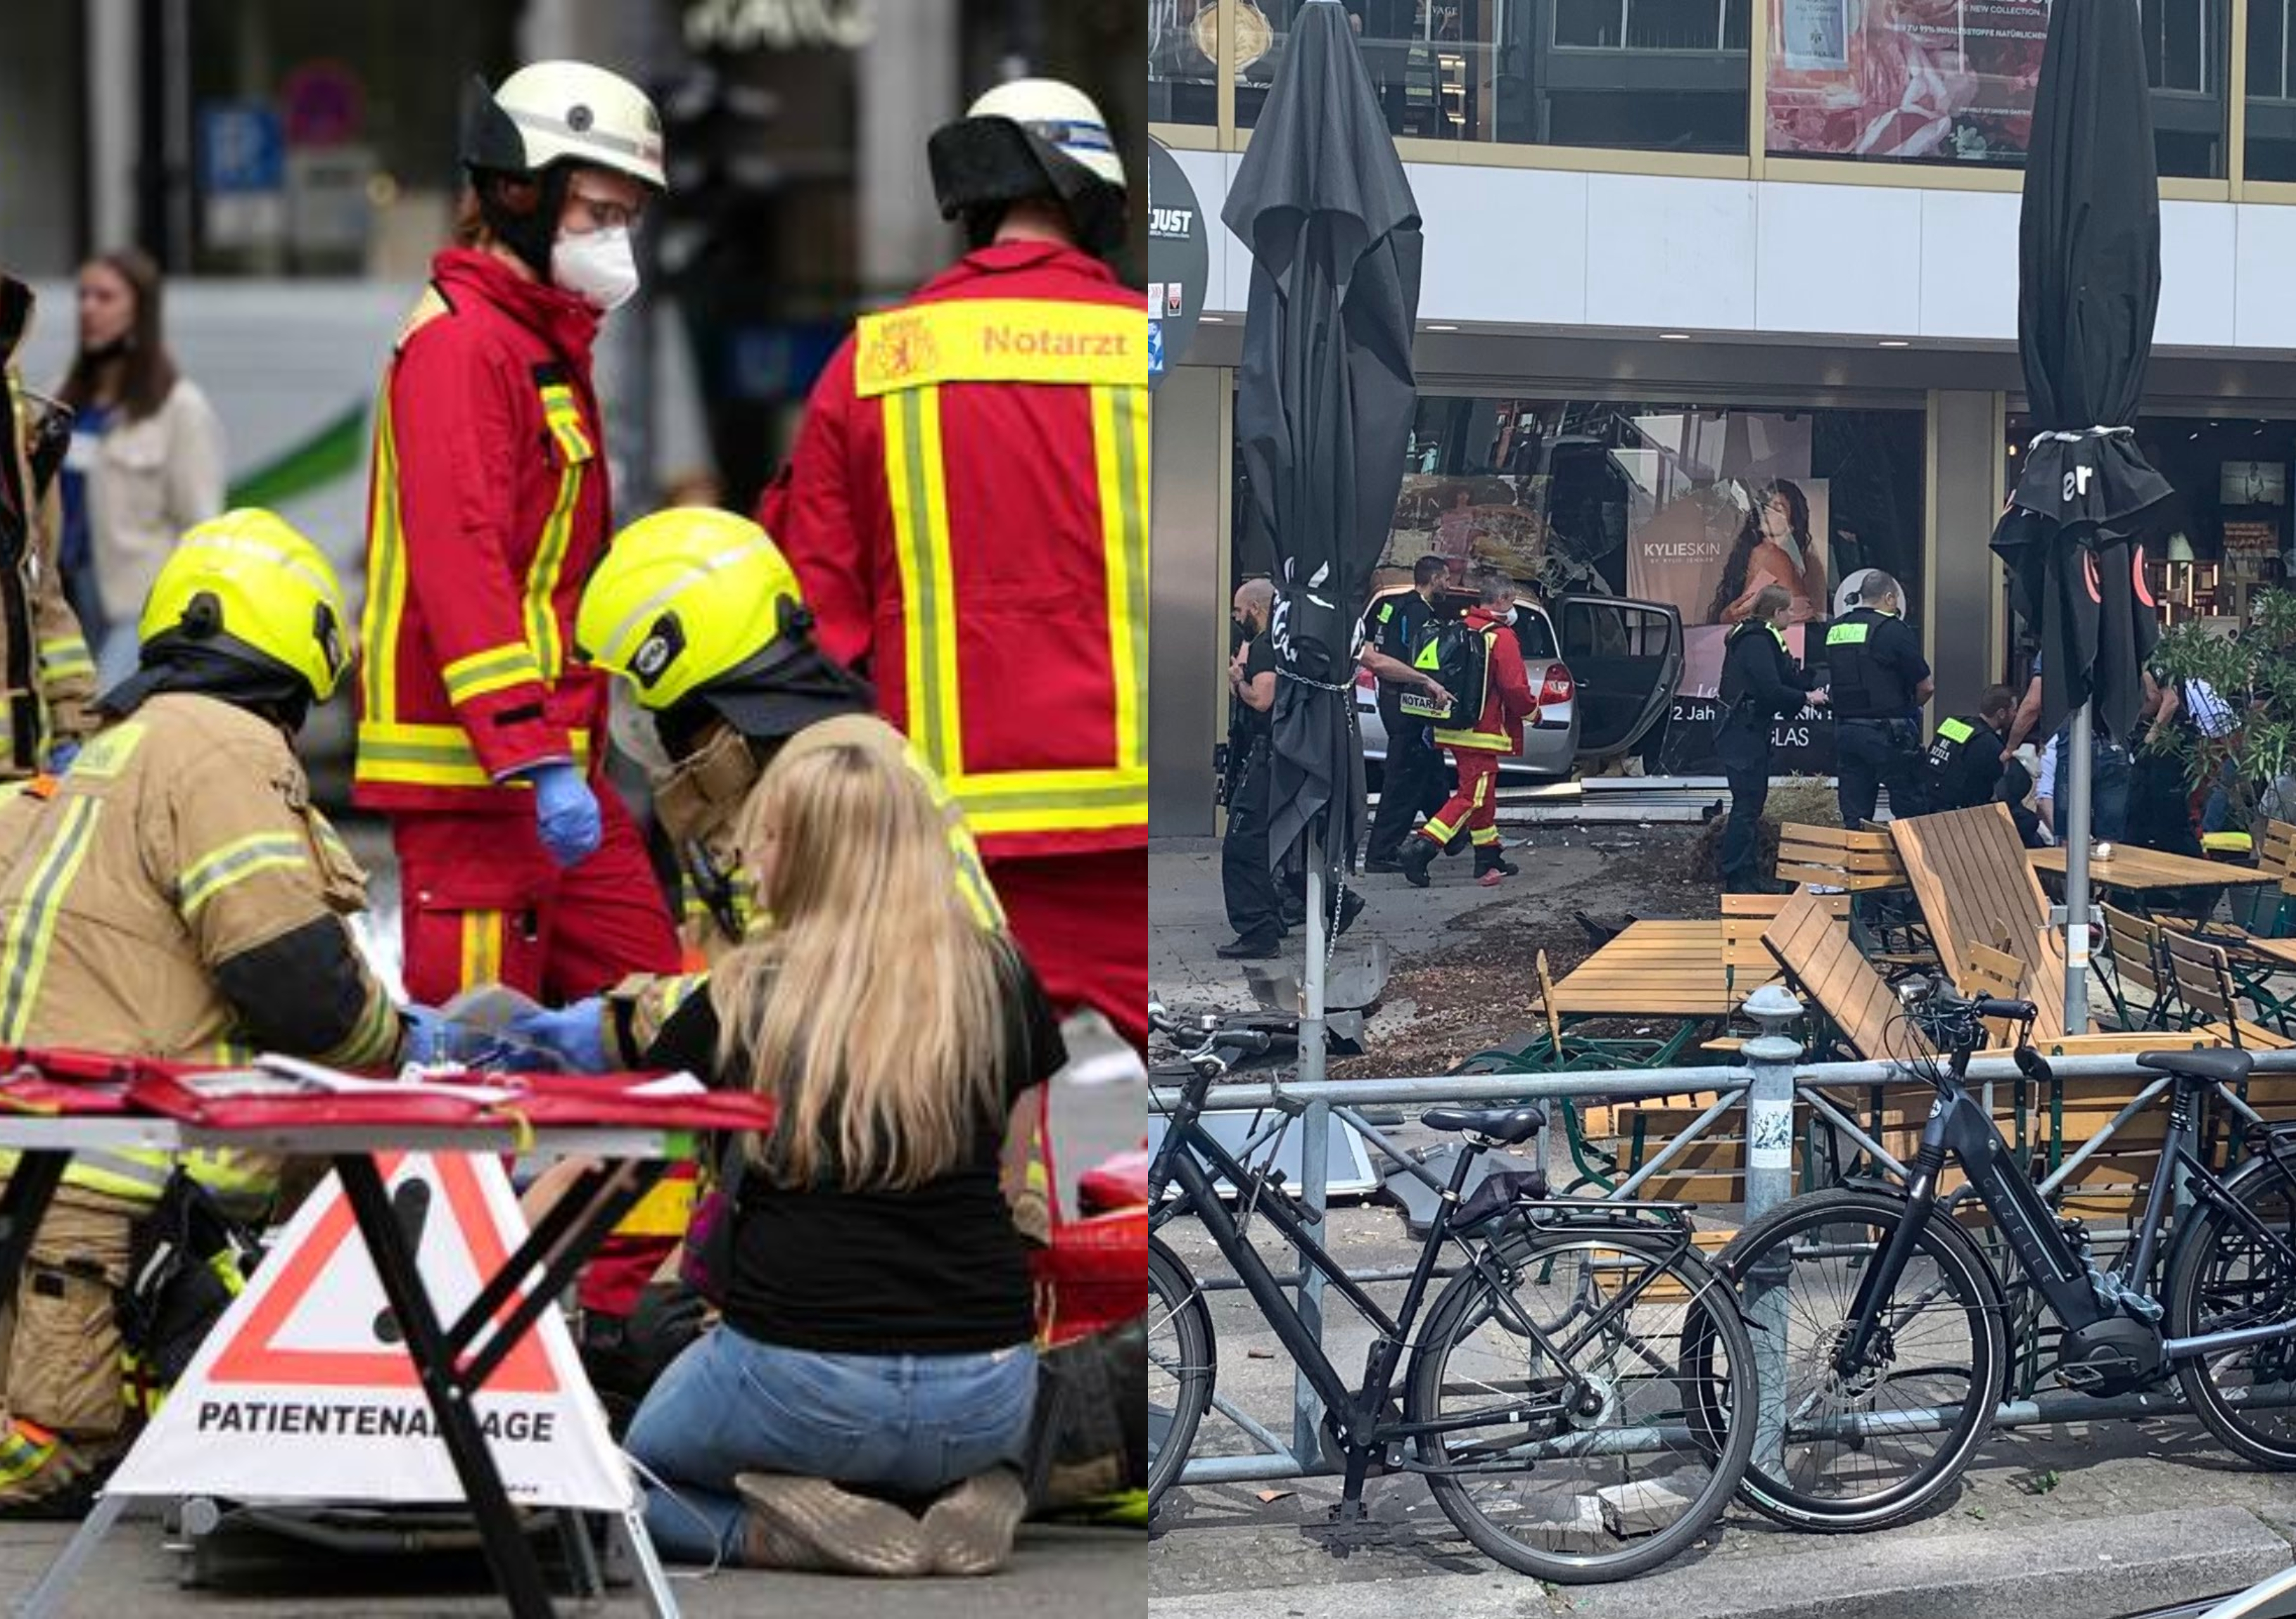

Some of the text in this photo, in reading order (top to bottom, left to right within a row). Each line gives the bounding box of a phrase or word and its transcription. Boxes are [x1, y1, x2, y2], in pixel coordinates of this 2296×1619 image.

[1990, 6, 2041, 16] COLLECTION
[1150, 209, 1192, 233] JUST
[983, 326, 1128, 357] Notarzt
[1673, 706, 1683, 720] 2
